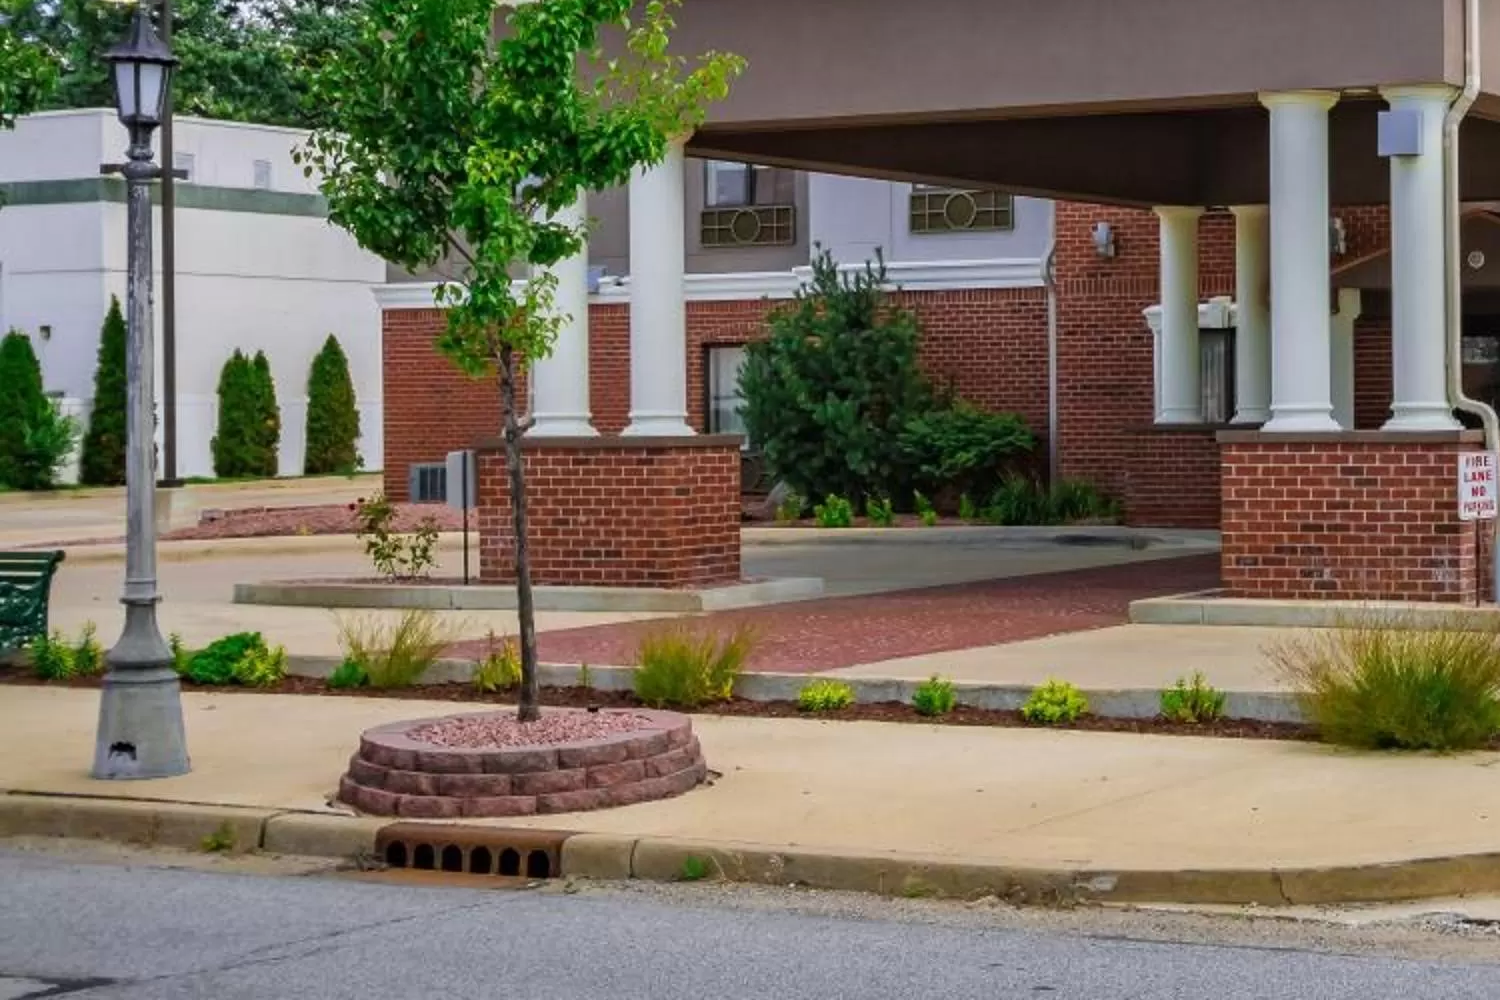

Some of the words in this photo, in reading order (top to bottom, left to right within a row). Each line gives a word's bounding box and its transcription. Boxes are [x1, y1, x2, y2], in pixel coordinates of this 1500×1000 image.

[1465, 455, 1493, 468] FIRE
[1463, 471, 1493, 483] LANE
[1471, 485, 1487, 497] NO
